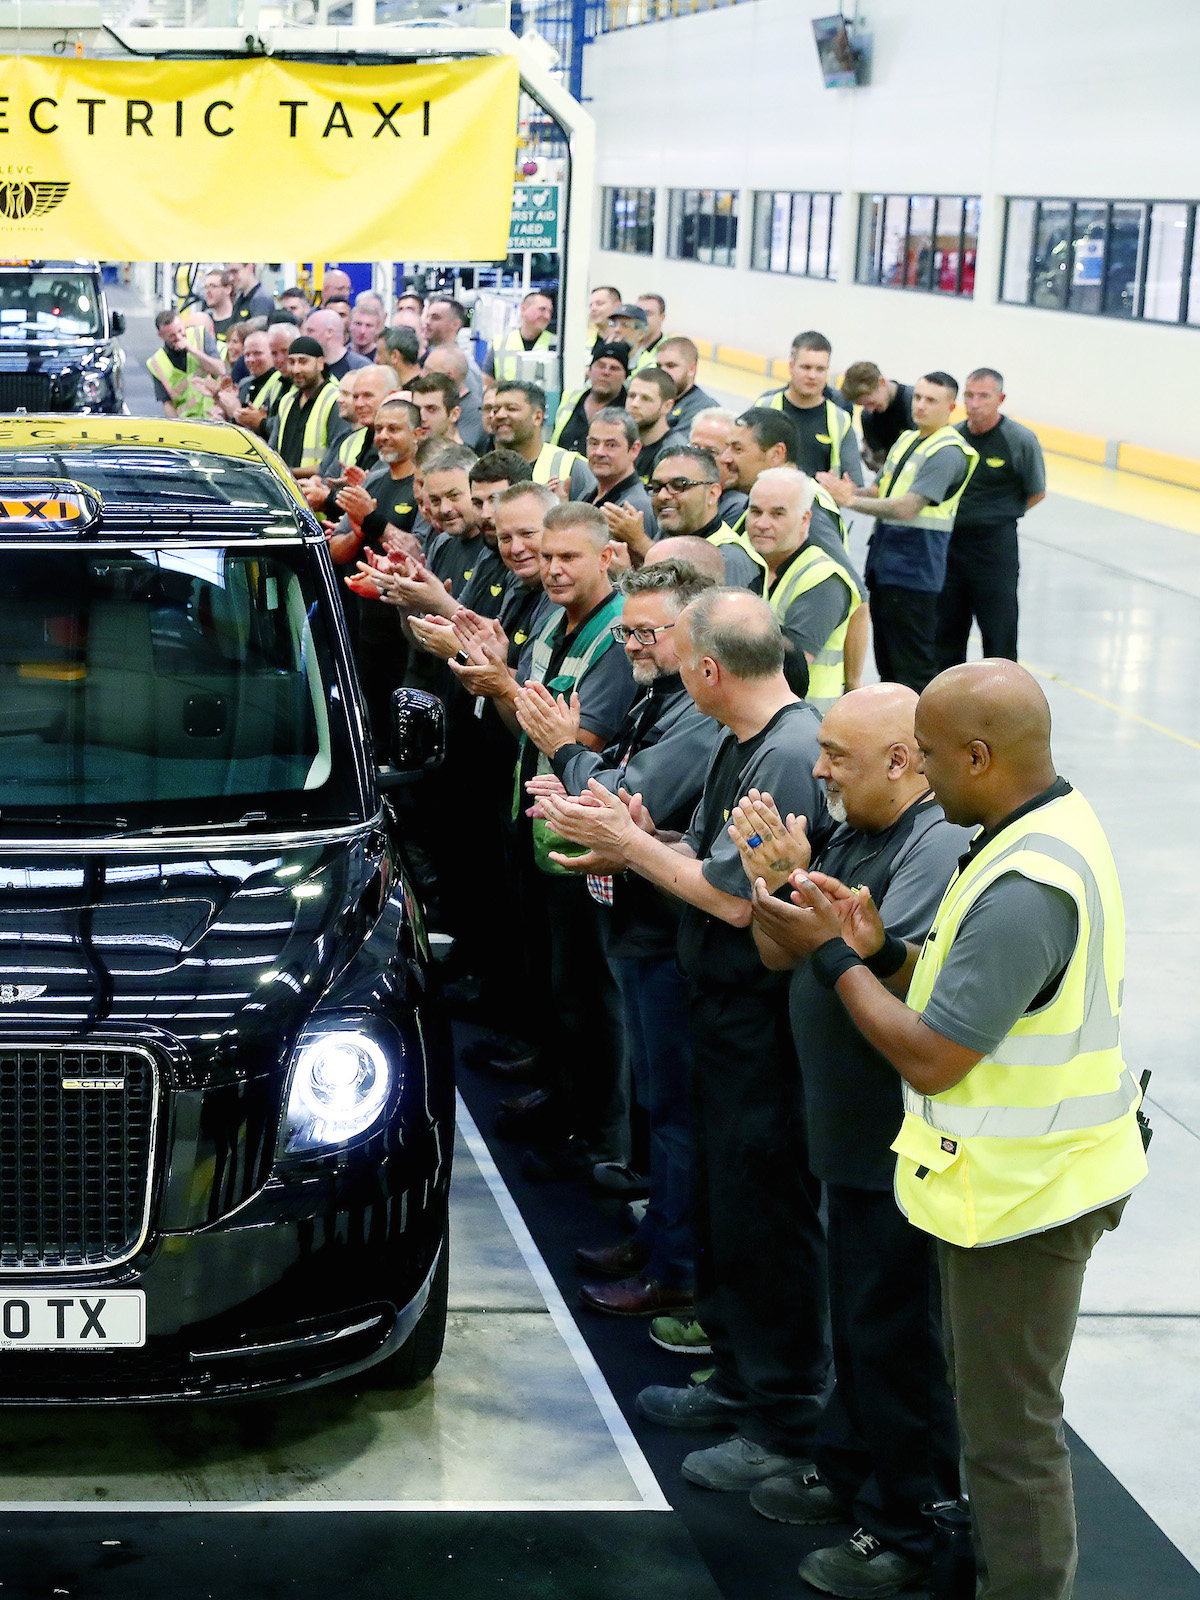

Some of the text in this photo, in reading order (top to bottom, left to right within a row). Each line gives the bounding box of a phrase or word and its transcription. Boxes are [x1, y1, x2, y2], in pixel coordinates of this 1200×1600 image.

[279, 100, 431, 138] TAXI
[535, 210, 556, 222] AID
[47, 1298, 107, 1339] TX
